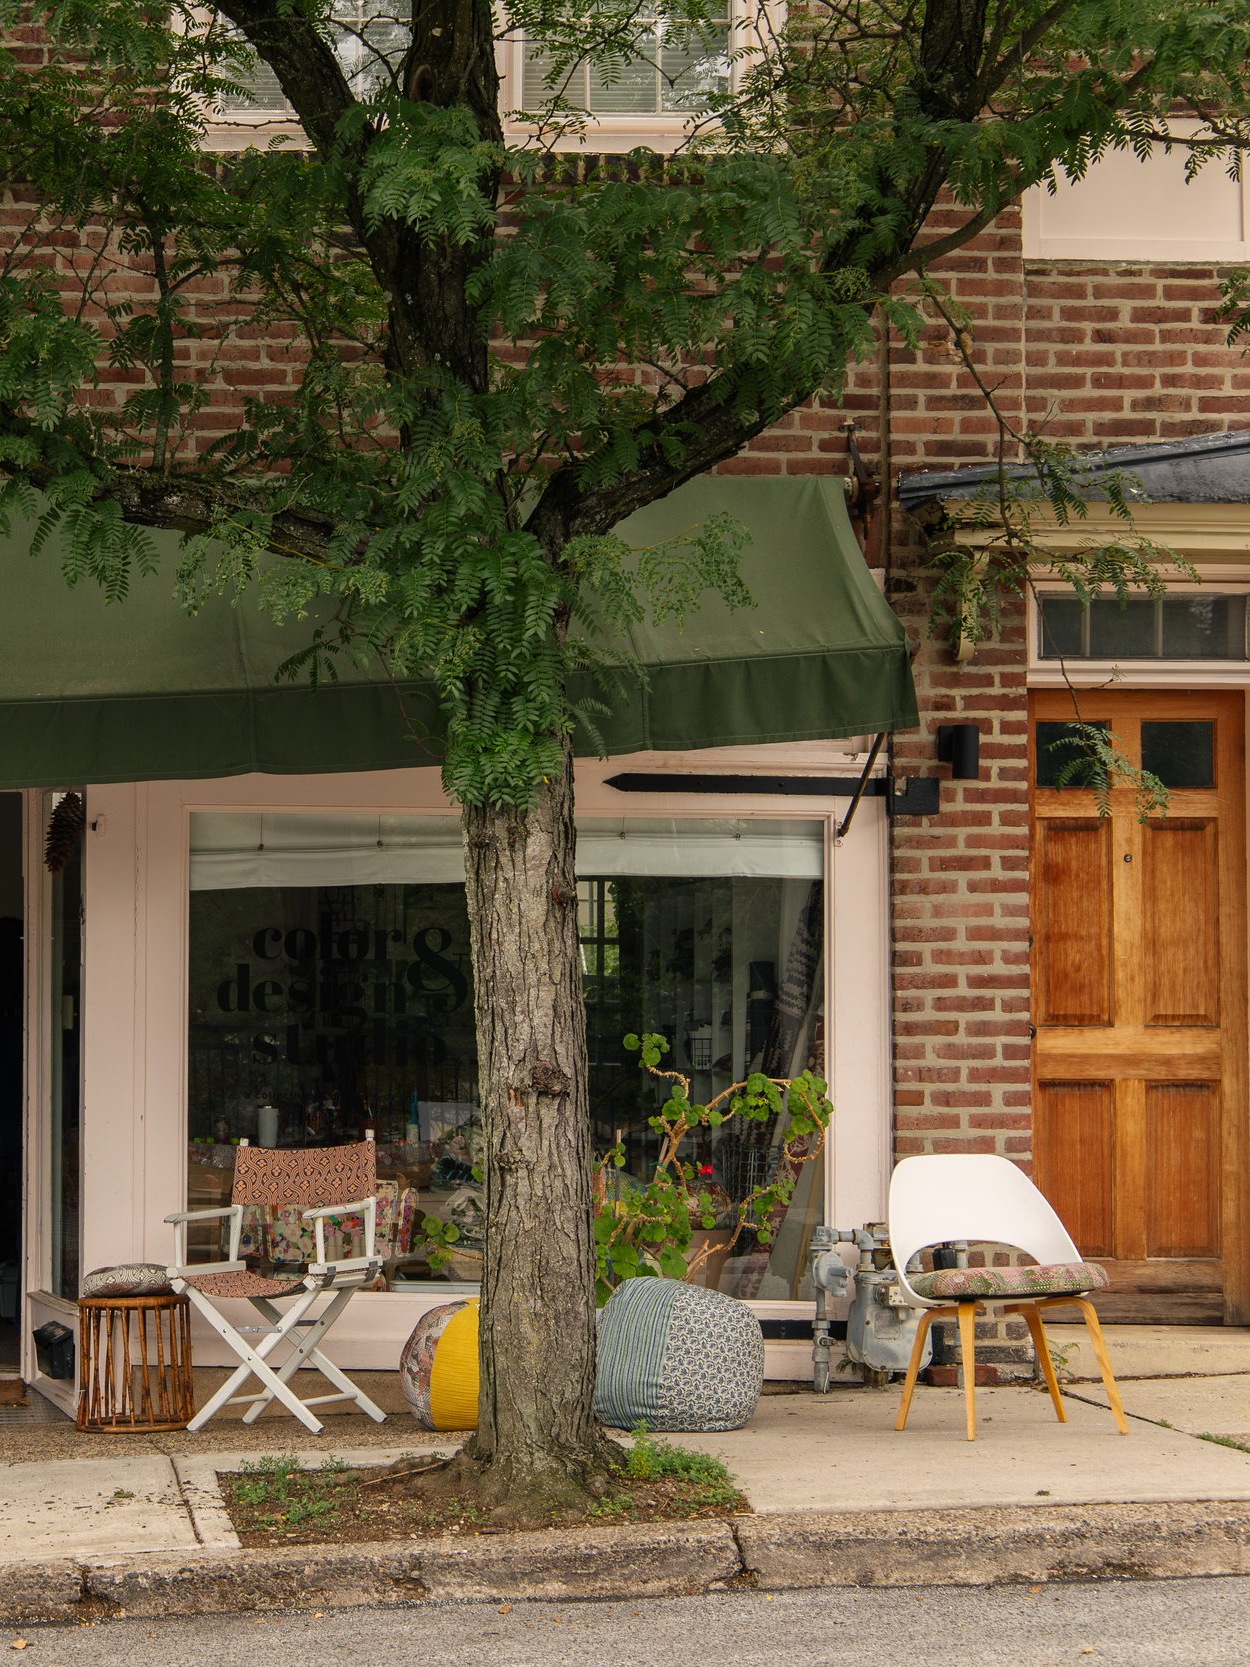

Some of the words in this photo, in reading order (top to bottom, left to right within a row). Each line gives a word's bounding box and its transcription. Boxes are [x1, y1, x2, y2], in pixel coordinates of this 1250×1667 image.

[216, 962, 407, 1027] design
[252, 911, 404, 961] color
[406, 926, 469, 1013] &
[252, 1018, 448, 1066] studio
